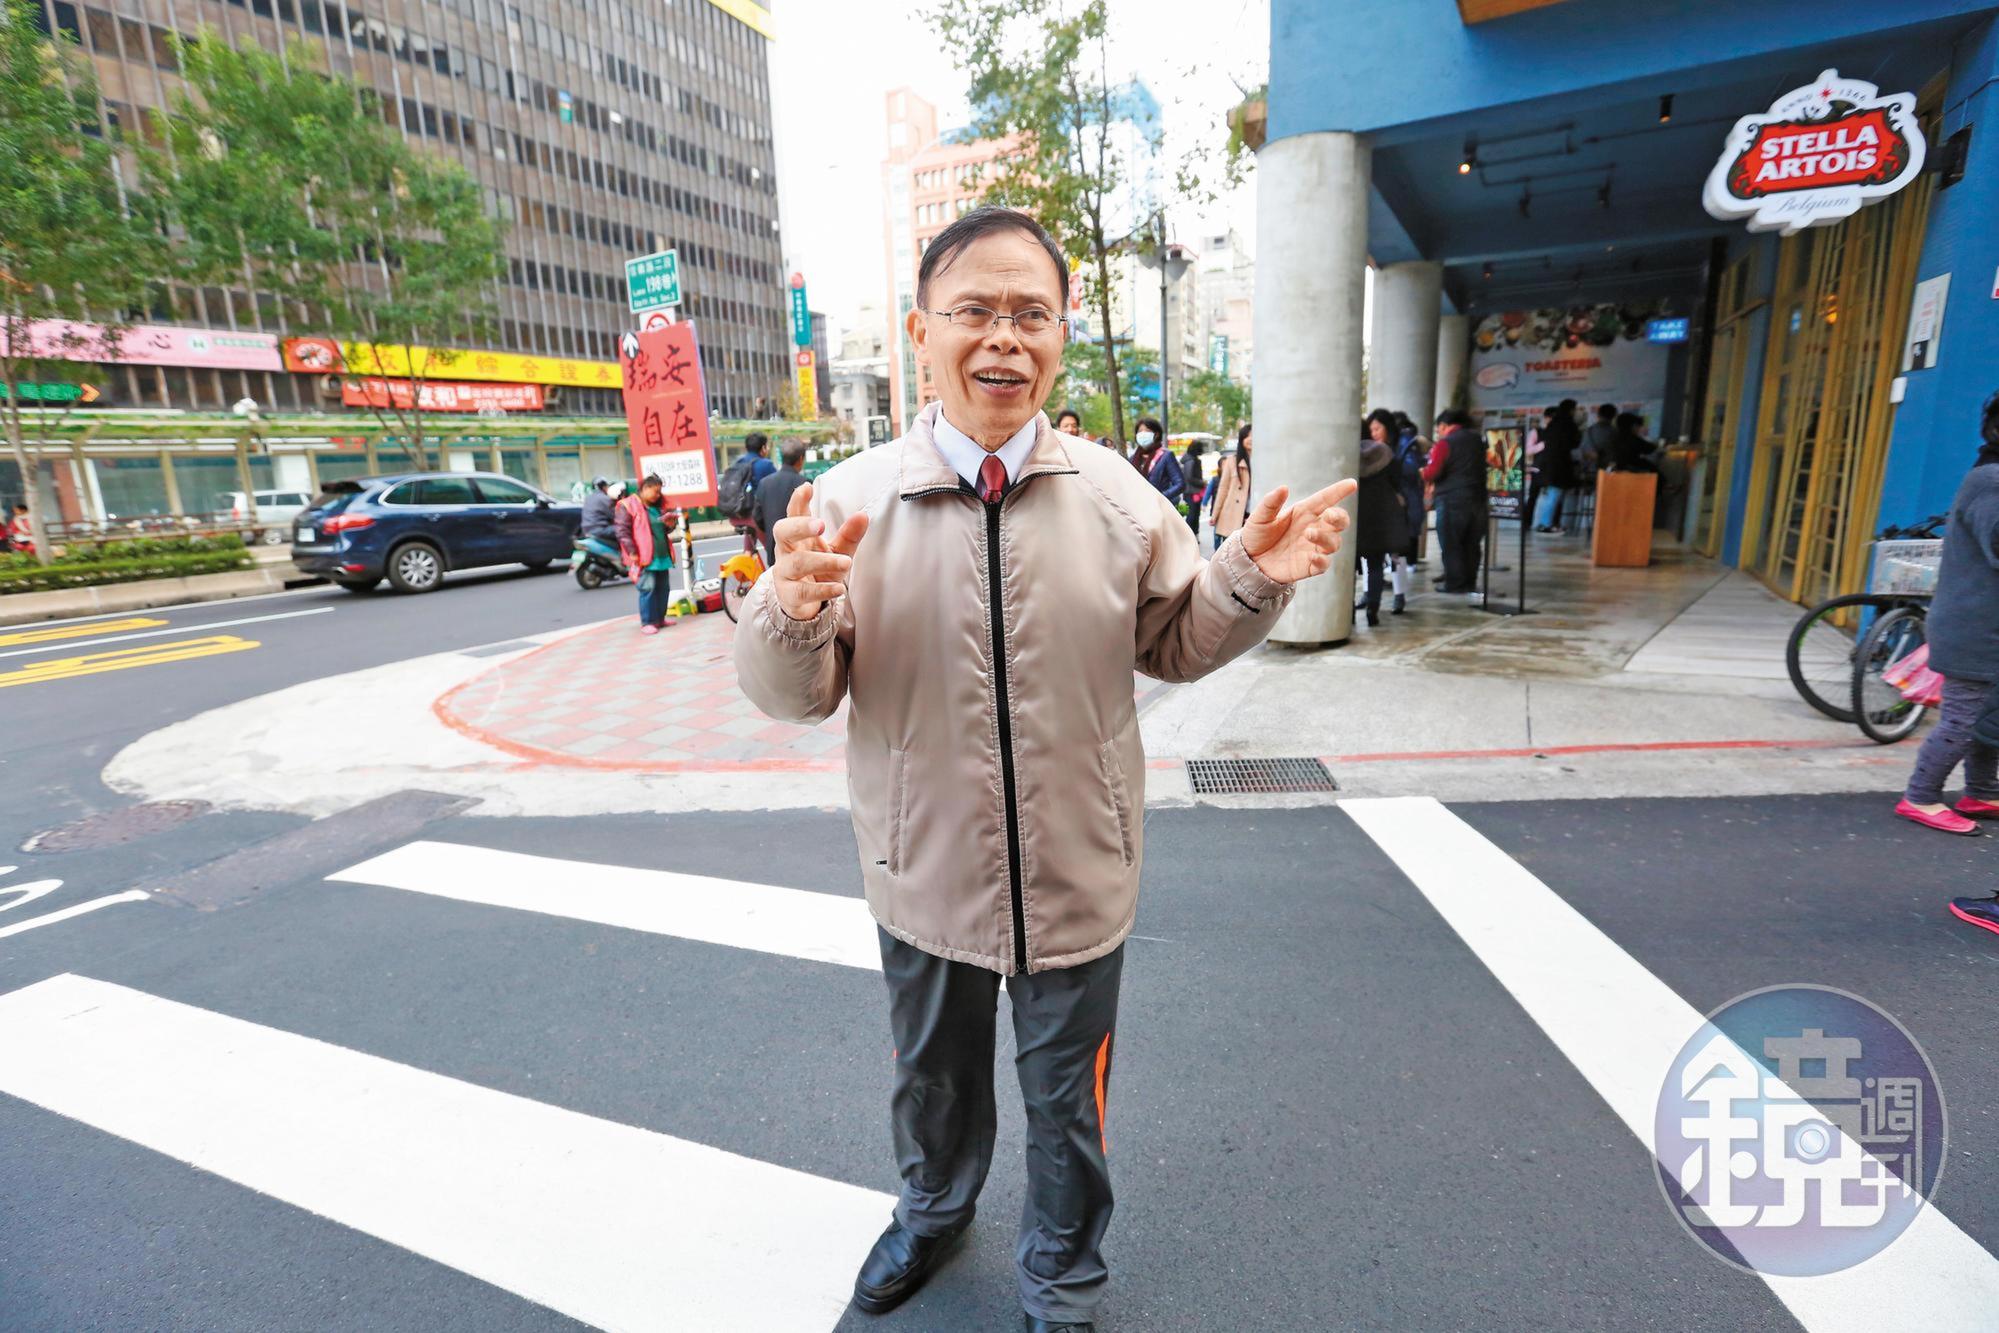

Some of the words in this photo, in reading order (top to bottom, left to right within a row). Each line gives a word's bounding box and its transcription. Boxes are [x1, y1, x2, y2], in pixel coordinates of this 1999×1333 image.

[1760, 124, 1879, 160] STELLA
[1754, 147, 1878, 183] ARTOIS
[1775, 194, 1852, 216] Belgium
[643, 399, 698, 447] 自在
